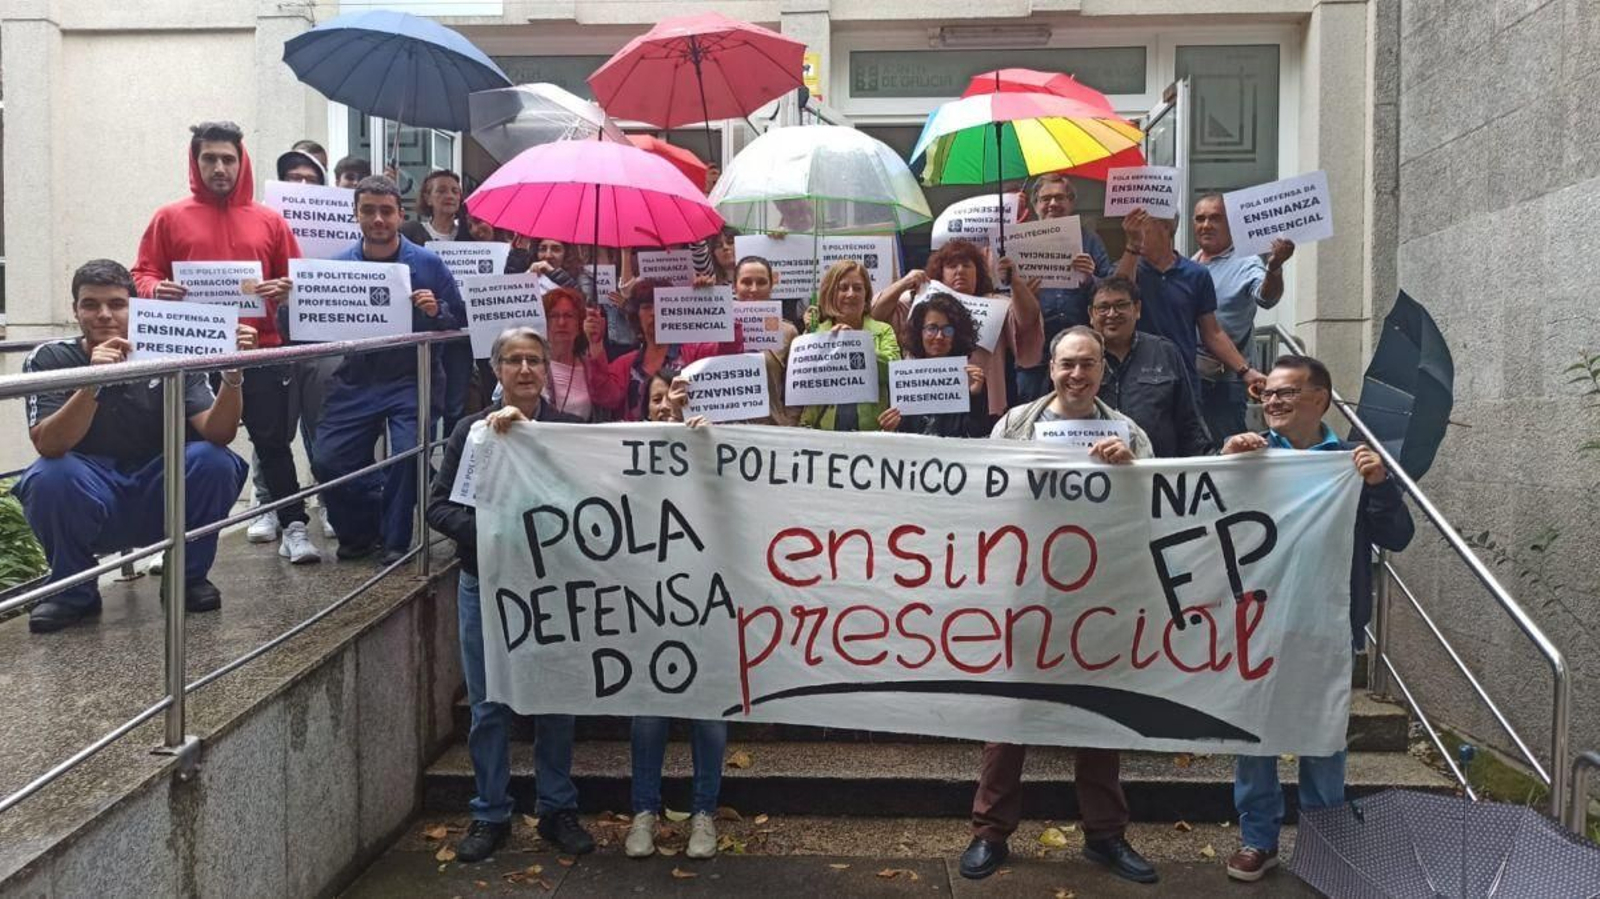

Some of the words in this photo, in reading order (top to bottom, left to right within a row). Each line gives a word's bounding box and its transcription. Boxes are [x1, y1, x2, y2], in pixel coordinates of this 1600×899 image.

[1112, 184, 1172, 193] ENSINANZA
[308, 198, 348, 208] DEFENSA
[1111, 196, 1170, 206] PRESENCIAL
[1240, 200, 1262, 210] POLA
[1264, 188, 1302, 204] DEFENSA
[1304, 184, 1316, 192] DA
[1243, 196, 1320, 224] ENSINANZA
[283, 210, 354, 224] ENSINANZ
[1248, 213, 1324, 240] PRESENCIAL
[1018, 252, 1072, 260] PRESENCIAL
[1018, 264, 1072, 272] ENSINANZA
[489, 284, 522, 292] DEFENSA
[298, 298, 368, 307] PROFESIONAL
[471, 294, 538, 308] ENSINANZA
[138, 310, 164, 318] POLA
[166, 313, 210, 322] DEFENSA
[300, 312, 388, 323] PRESENCIAL
[472, 308, 540, 322] PRESENCIAL
[660, 307, 726, 316] ENSINANZA
[660, 321, 728, 330] PRESENCIAL
[137, 324, 227, 340] ENSINANZA
[792, 364, 849, 375] PROFESIONAL
[792, 376, 866, 390] PRESENCIAL
[896, 377, 960, 388] ENSINANZA
[688, 384, 762, 400] ENSINANZA
[896, 392, 962, 402] PRESENCIAL
[703, 402, 740, 412] DEFENSA
[742, 400, 763, 408] POLA
[622, 440, 689, 476] IES
[1027, 469, 1112, 503] VIGO
[1151, 472, 1226, 518] NA
[523, 494, 704, 578] POLA
[766, 524, 1098, 592] ensino
[496, 572, 737, 652] DEFENSA
[738, 589, 1274, 716] presencial
